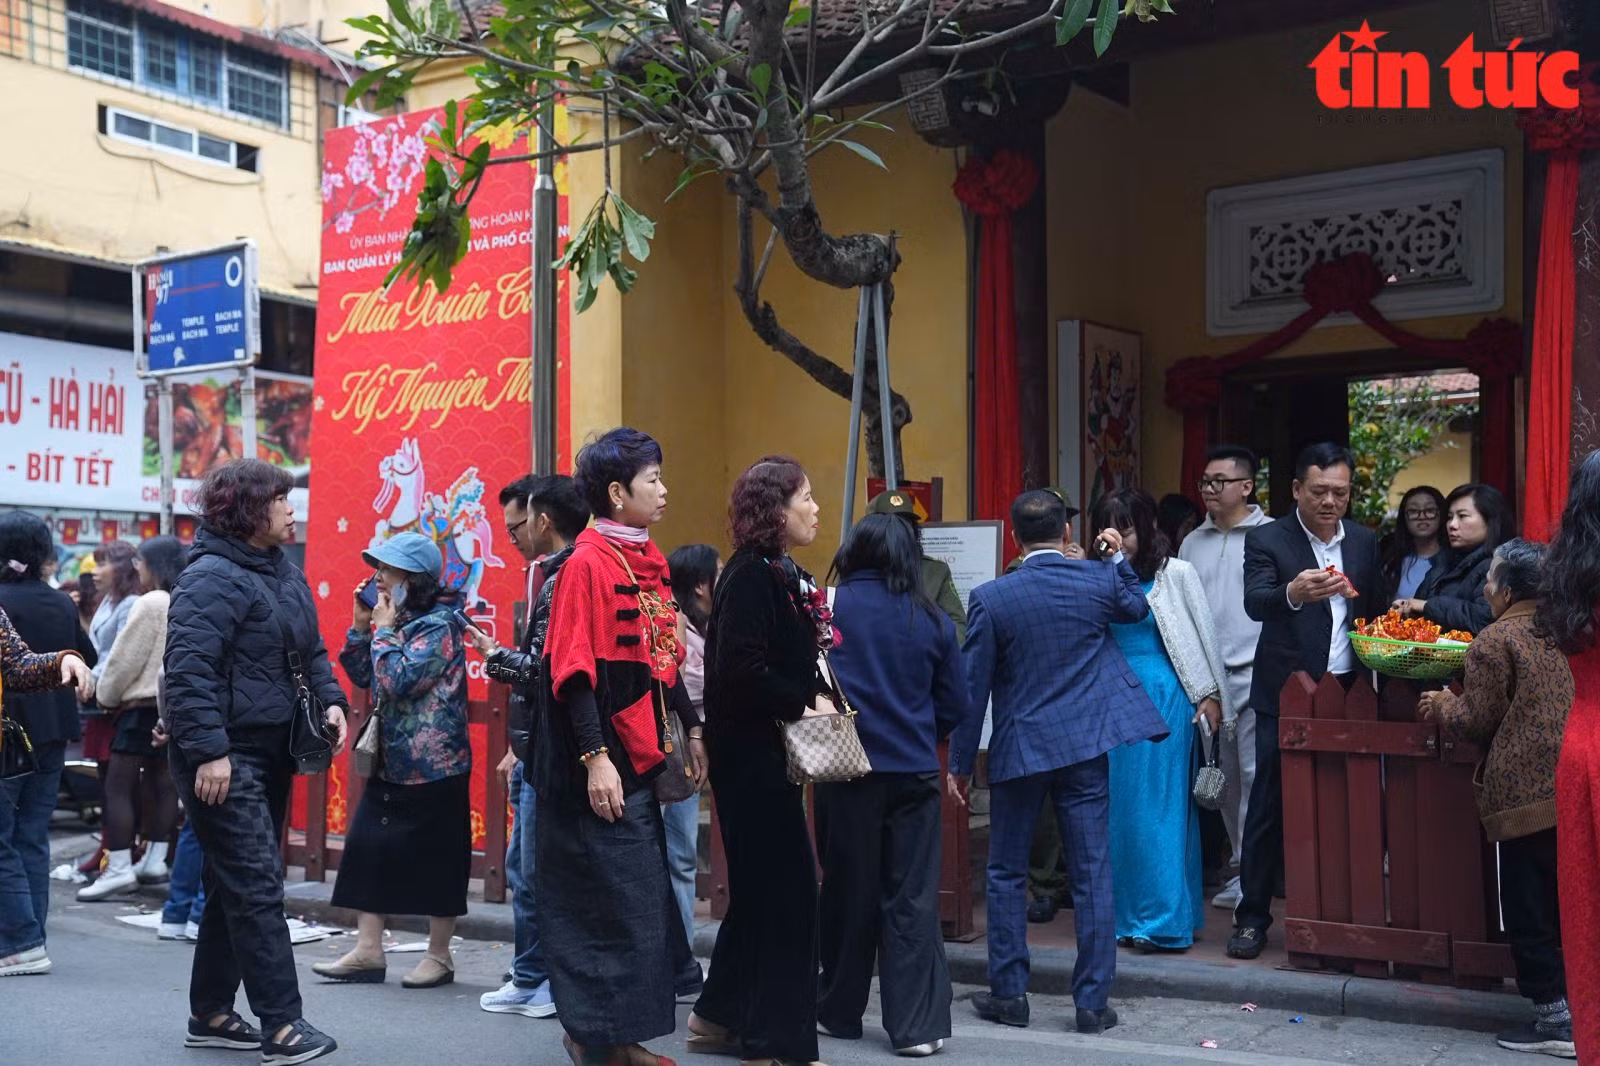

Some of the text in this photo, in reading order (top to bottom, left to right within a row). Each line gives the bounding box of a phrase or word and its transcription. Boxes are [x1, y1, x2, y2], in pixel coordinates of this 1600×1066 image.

[364, 232, 386, 248] BAN
[473, 234, 490, 252] VÀ
[491, 229, 518, 249] PHỐ
[323, 259, 346, 274] BAN
[347, 253, 378, 273] QUẢN
[375, 362, 489, 431] Nguyên
[27, 446, 64, 483] BÍT
[74, 448, 114, 486] TẾT
